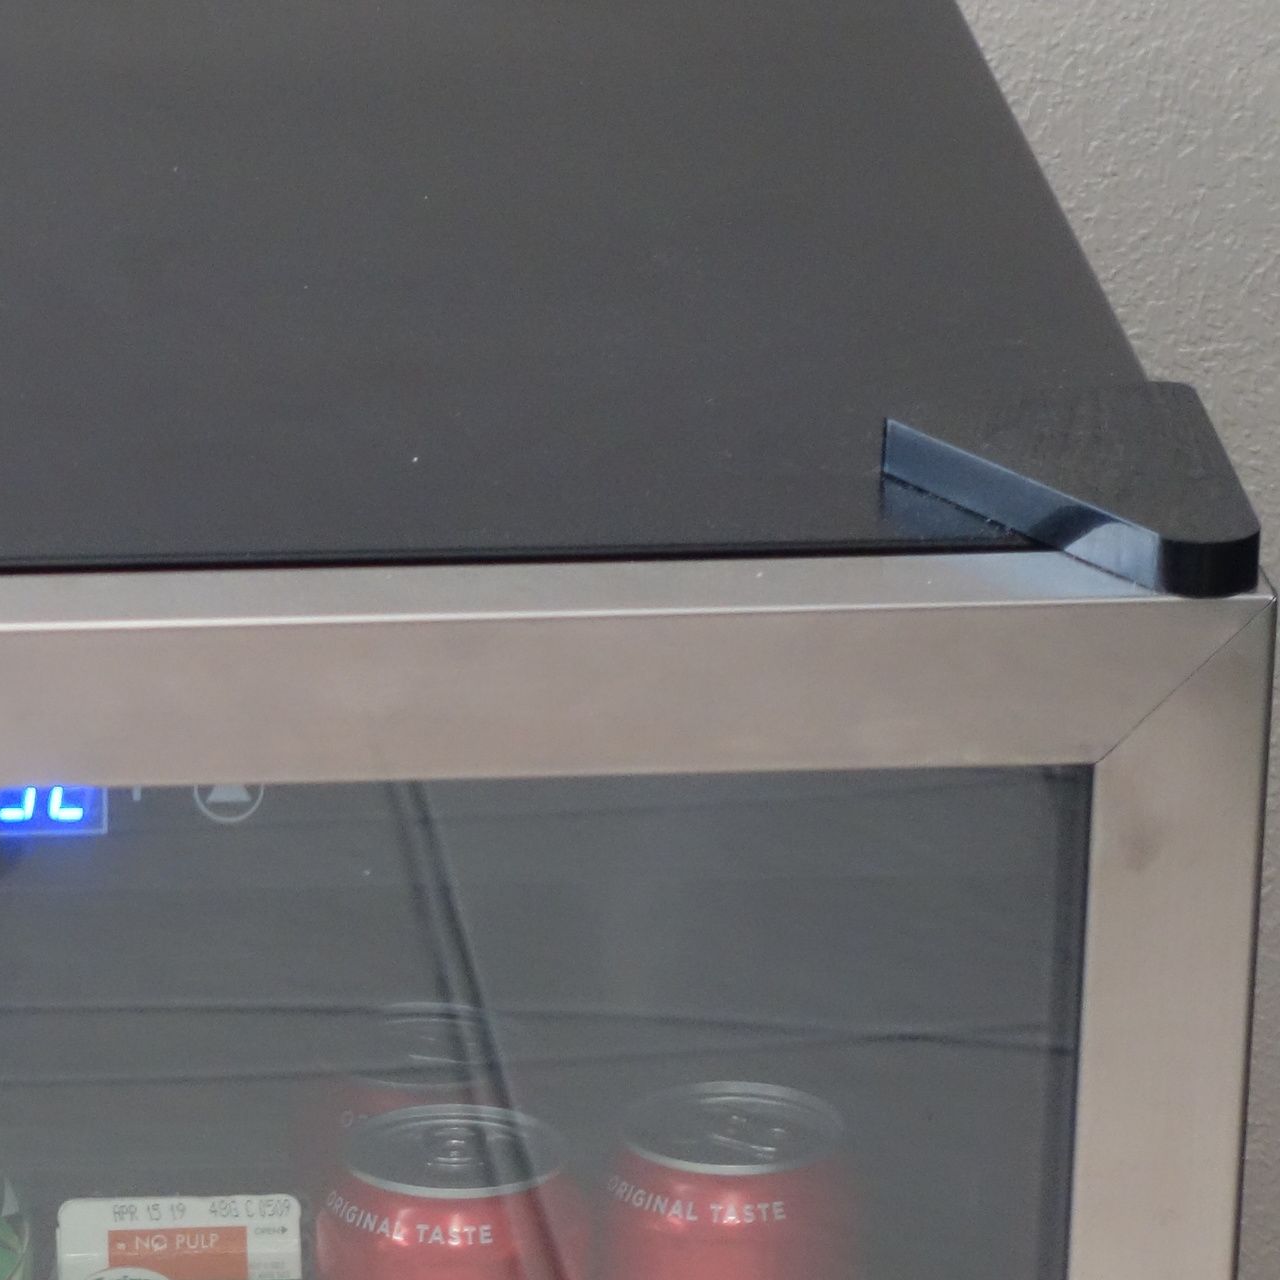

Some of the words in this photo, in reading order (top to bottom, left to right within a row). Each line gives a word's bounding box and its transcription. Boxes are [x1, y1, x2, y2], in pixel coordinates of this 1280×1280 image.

[112, 1204, 138, 1221] APR
[169, 1202, 187, 1219] 19
[606, 1174, 698, 1222] ORIGINAL
[710, 1201, 787, 1225] TASTE
[325, 1190, 410, 1245] ORIGINAL
[416, 1223, 494, 1247] TASTE
[134, 1235, 167, 1250] NO
[175, 1233, 220, 1249] PULP
